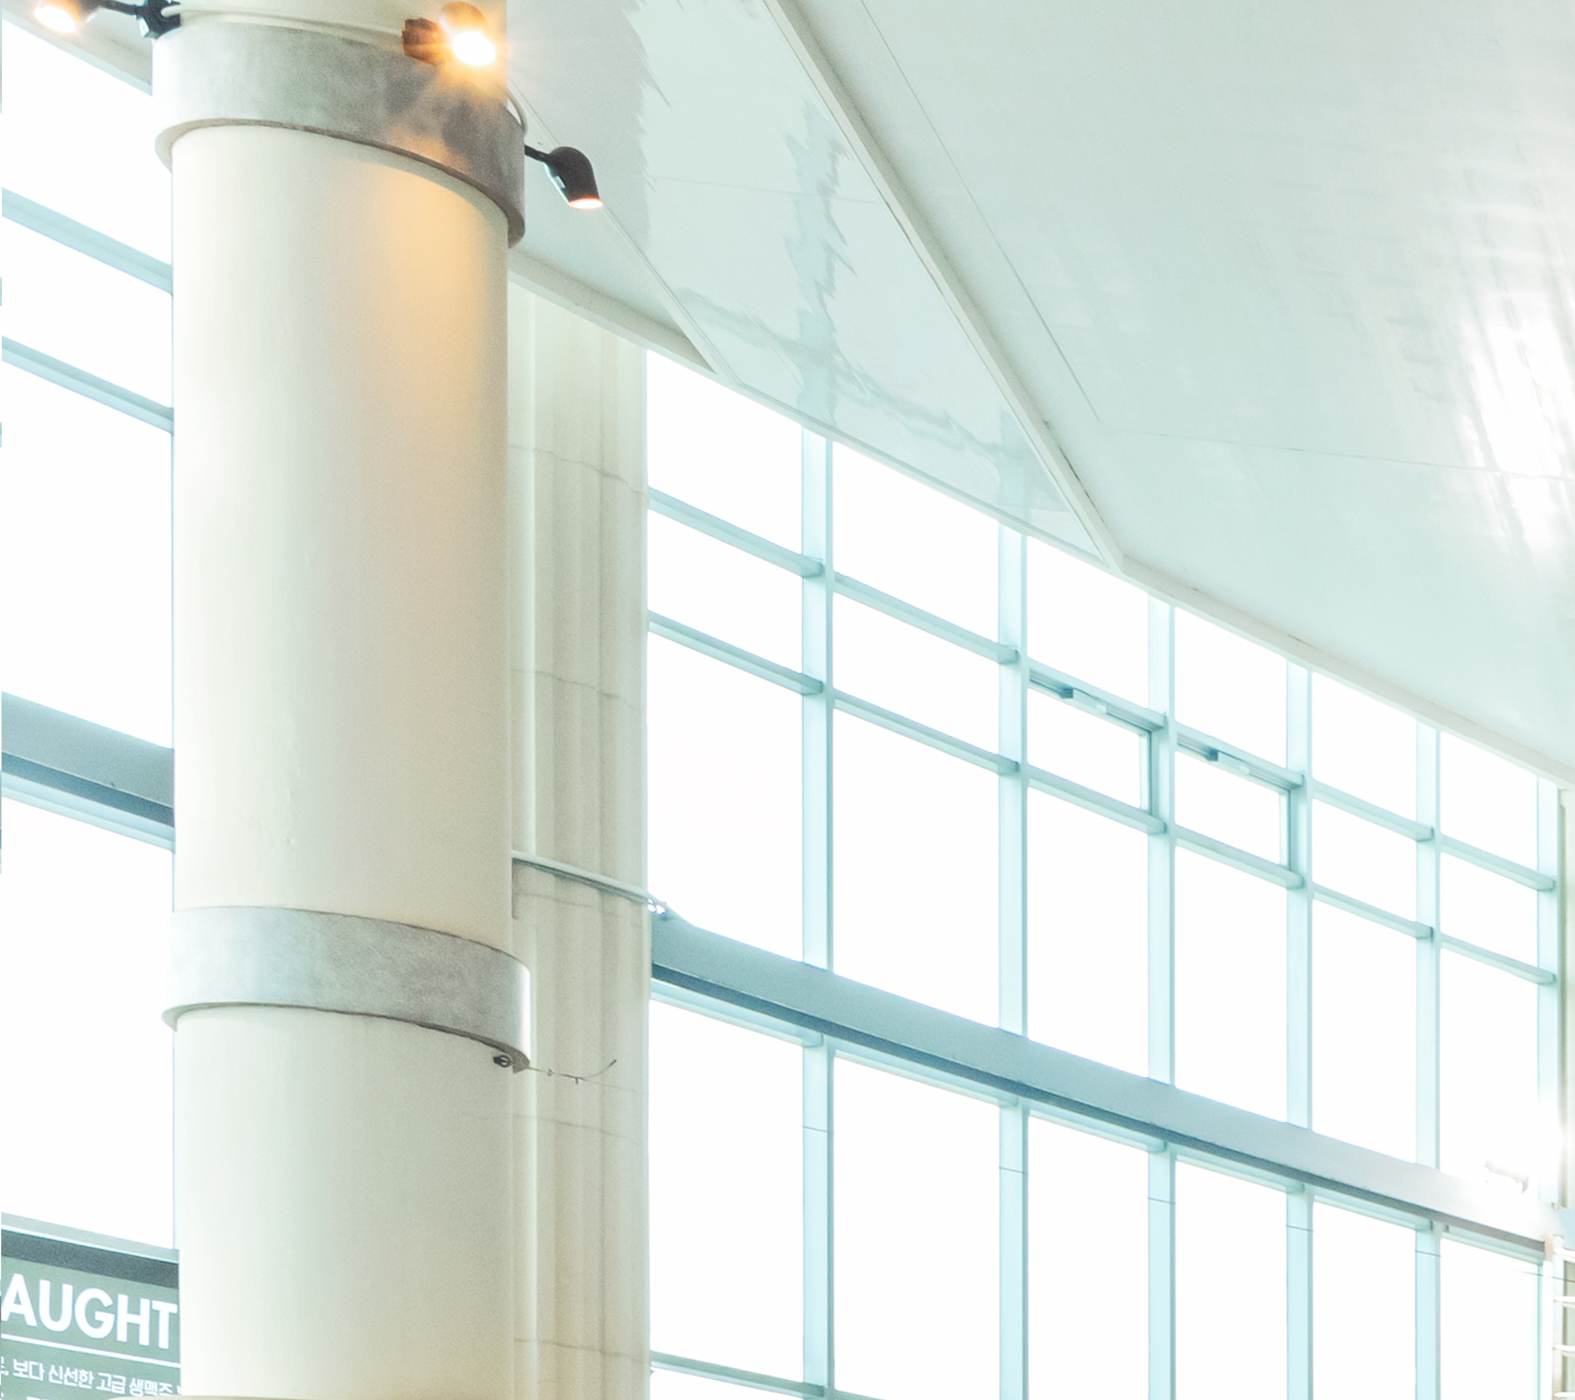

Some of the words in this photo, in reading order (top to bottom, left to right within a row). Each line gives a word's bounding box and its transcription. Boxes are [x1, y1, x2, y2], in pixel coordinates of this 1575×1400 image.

[12, 1358, 45, 1381] 보다
[48, 1364, 95, 1389] 신선한
[96, 1372, 127, 1395] 고급
